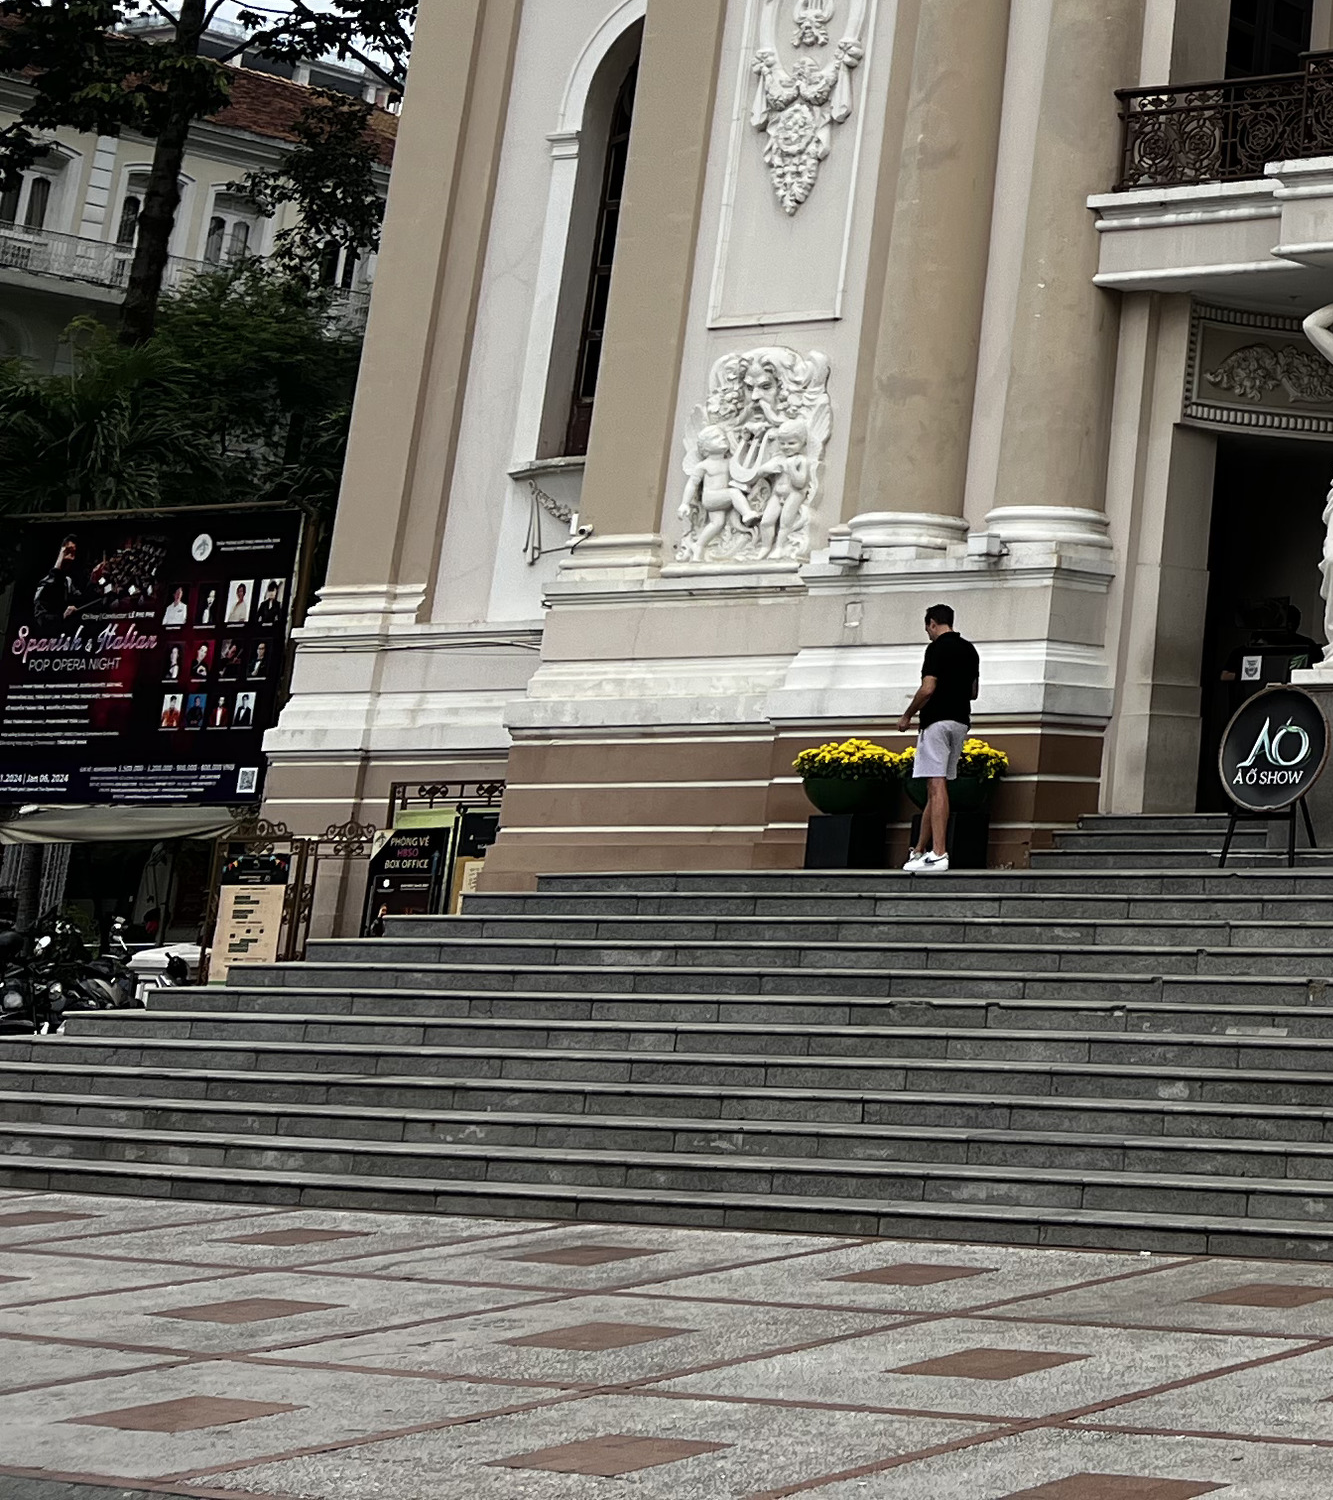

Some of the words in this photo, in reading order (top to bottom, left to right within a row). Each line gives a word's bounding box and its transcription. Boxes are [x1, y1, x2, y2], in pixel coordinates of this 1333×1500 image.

[12, 625, 84, 664] Spanish
[85, 638, 93, 652] &
[95, 623, 158, 654] Italian
[28, 659, 50, 672] POP
[52, 658, 86, 671] OPERA
[88, 657, 122, 670] NIGHT
[1259, 770, 1304, 785] SHOW
[384, 860, 400, 869] BOX
[401, 859, 429, 868] OFFICE
